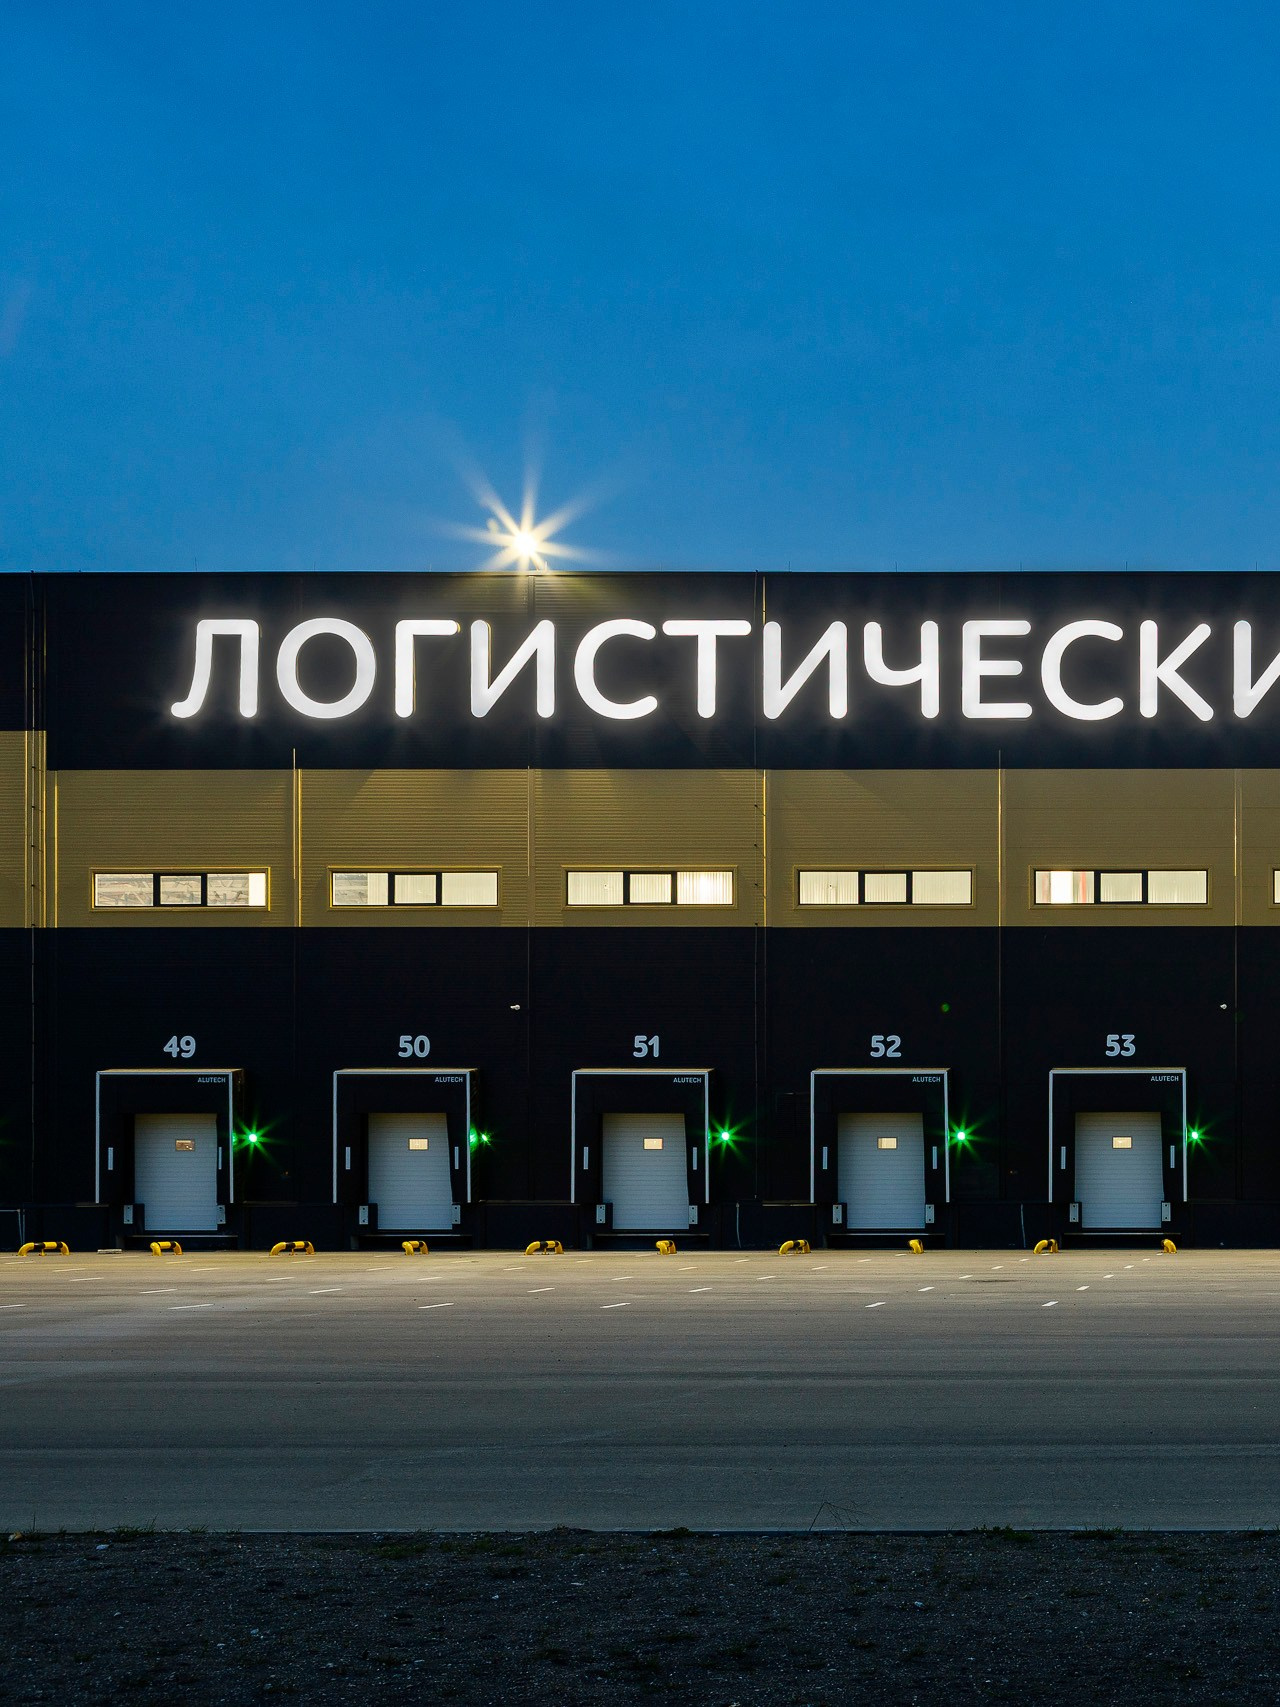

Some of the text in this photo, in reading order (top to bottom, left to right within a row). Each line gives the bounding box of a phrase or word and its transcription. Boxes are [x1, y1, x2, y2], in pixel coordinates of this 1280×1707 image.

[164, 1036, 196, 1058] 49
[398, 1035, 430, 1057] 50
[633, 1036, 660, 1057] 51
[870, 1035, 902, 1057] 52
[1105, 1035, 1136, 1057] 53
